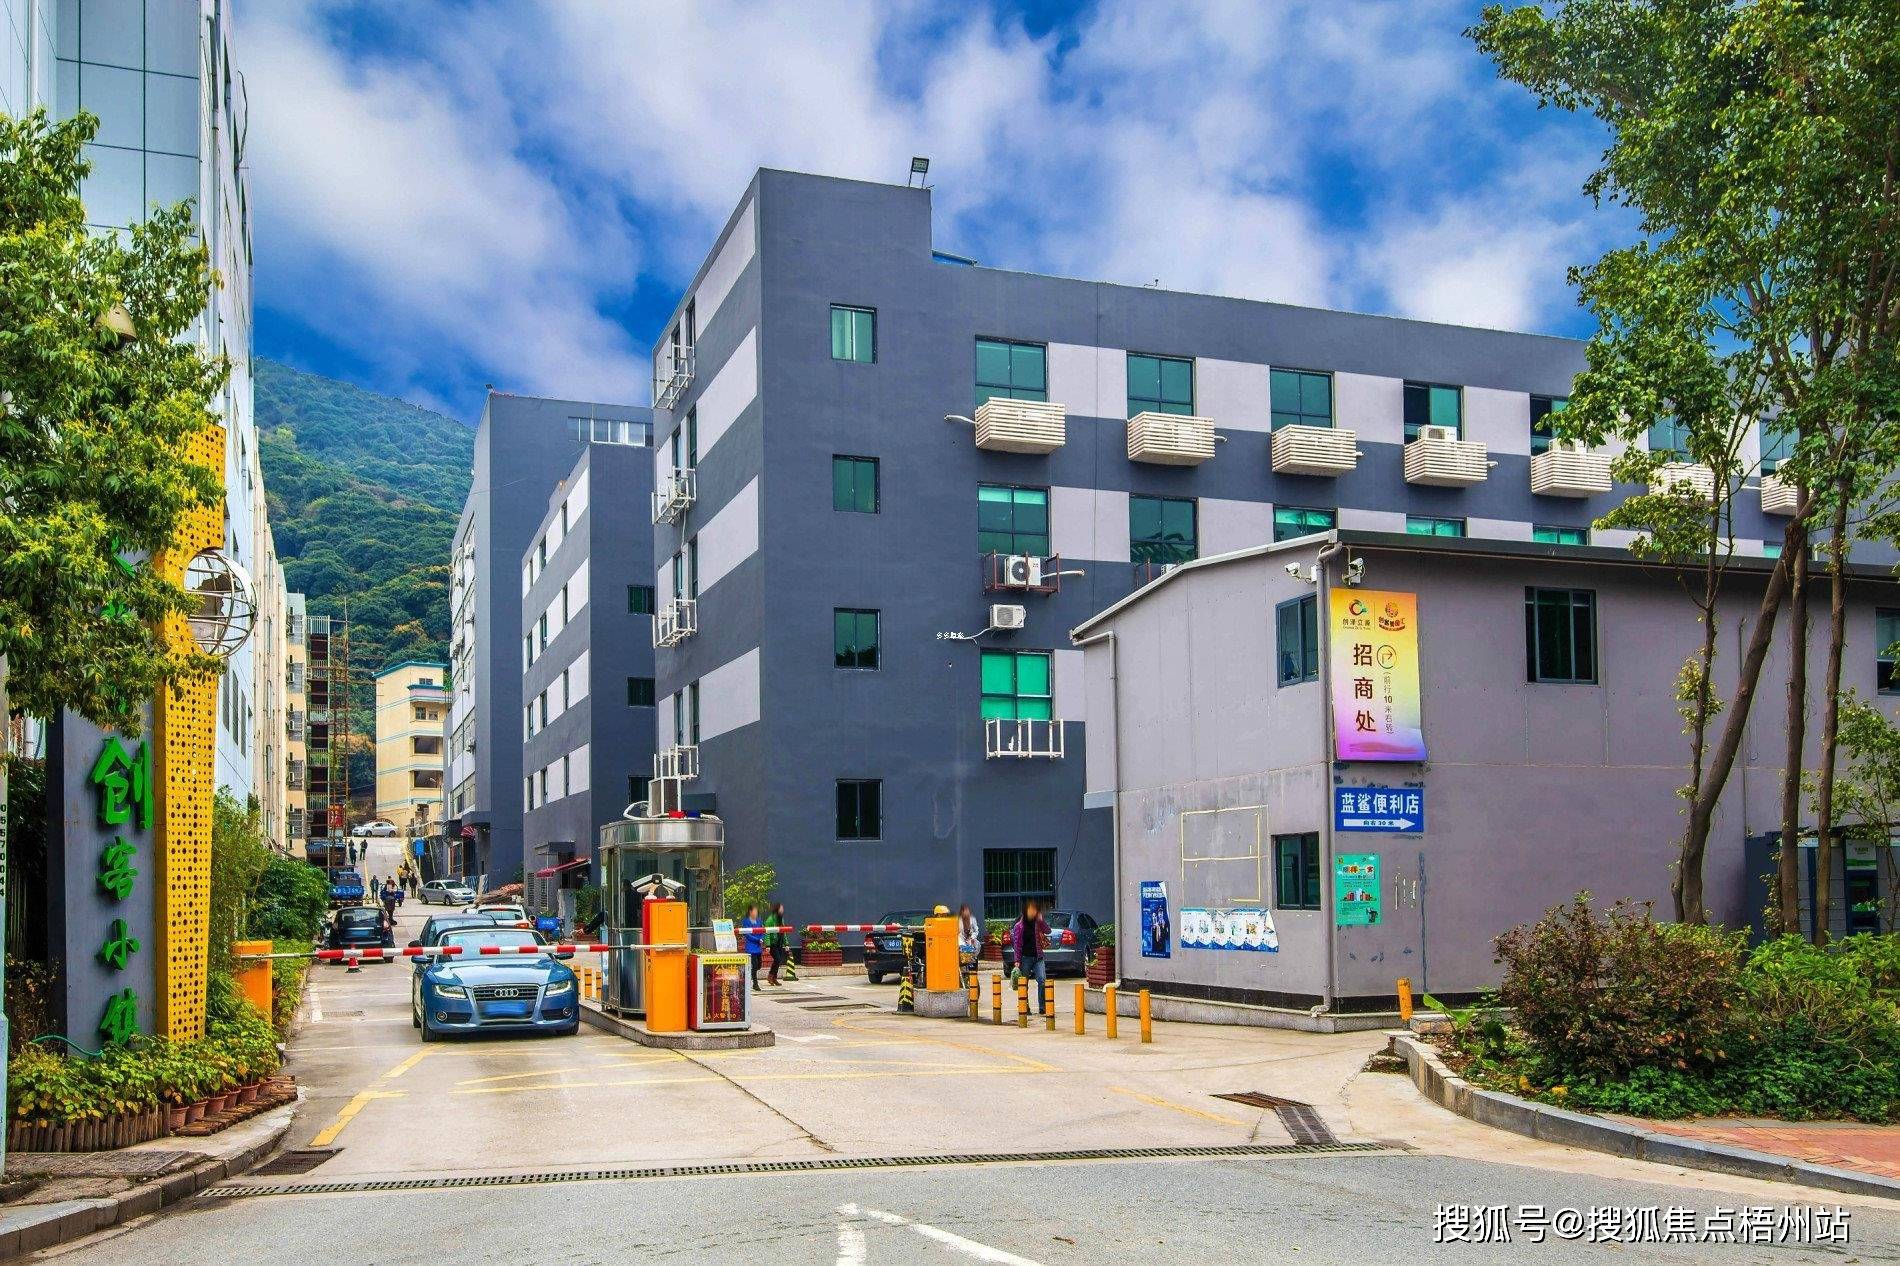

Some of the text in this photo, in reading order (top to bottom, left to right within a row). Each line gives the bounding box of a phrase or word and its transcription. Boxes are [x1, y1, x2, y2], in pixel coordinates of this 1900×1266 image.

[1353, 643, 1377, 732] 招商处
[1341, 793, 1419, 814] 蓝鲨便利店
